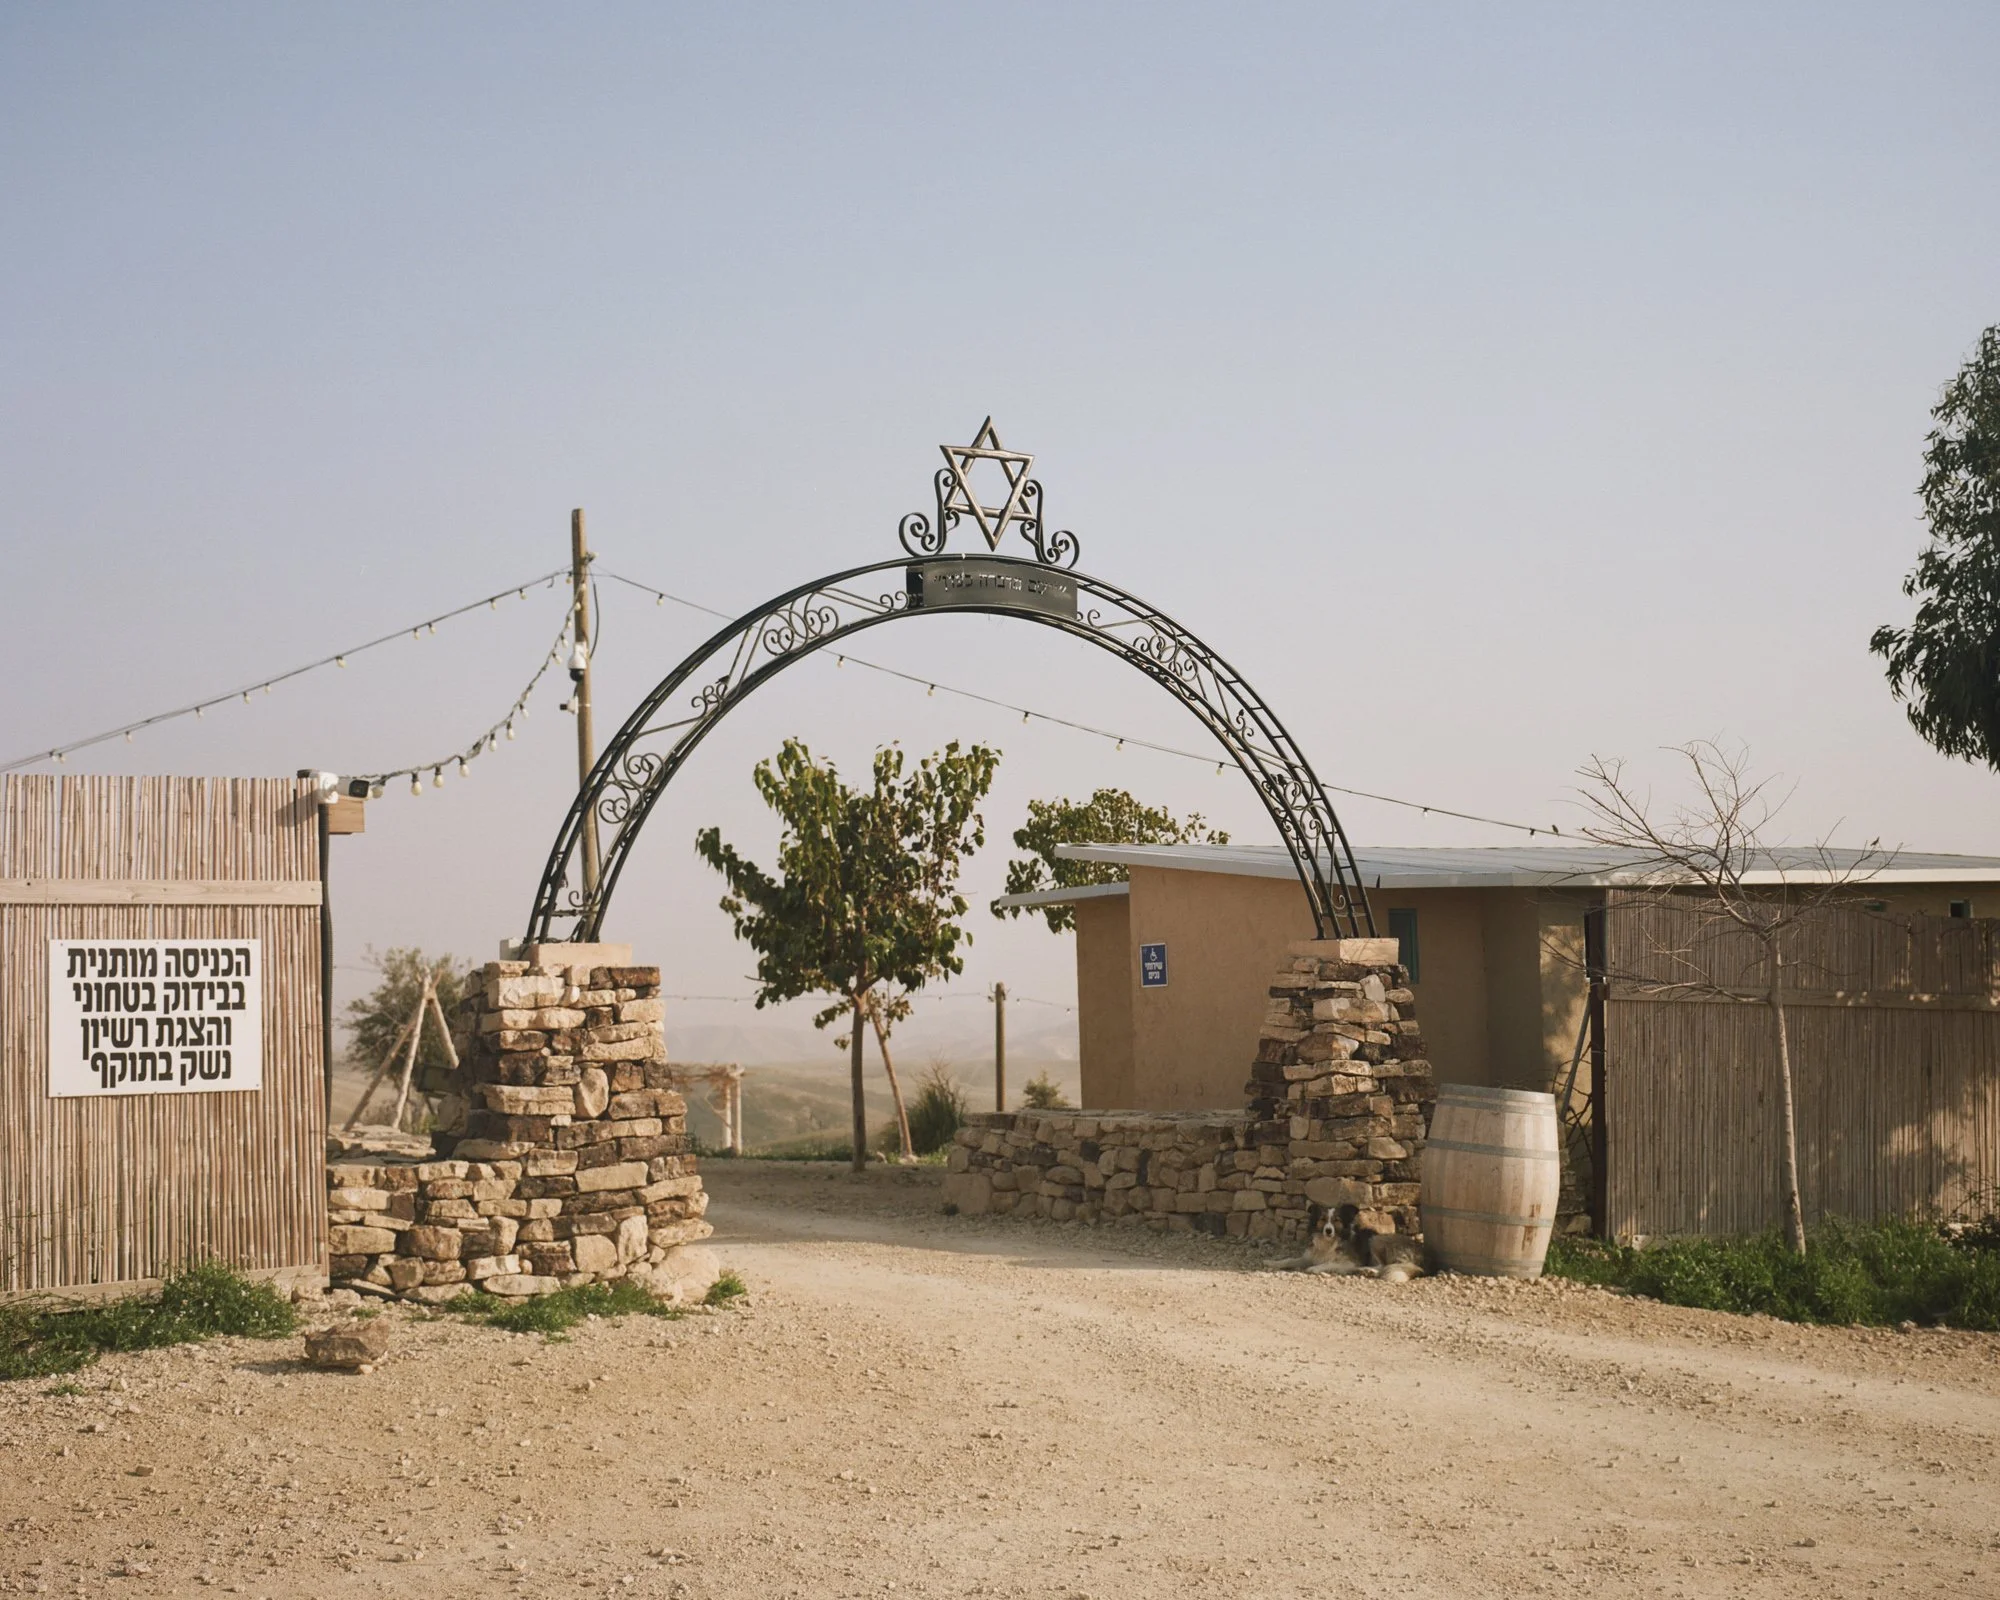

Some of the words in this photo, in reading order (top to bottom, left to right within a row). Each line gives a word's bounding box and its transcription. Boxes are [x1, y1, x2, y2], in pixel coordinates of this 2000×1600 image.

[67, 947, 157, 978] מותנית
[166, 947, 250, 978] הכניסה
[1148, 971, 1160, 980] נכים
[73, 982, 157, 1012] בטחוני
[164, 982, 245, 1014] בבידוק
[81, 1018, 148, 1060] רשיון
[156, 1017, 231, 1047] והצגת
[91, 1052, 173, 1088] בתוקף
[181, 1051, 231, 1086] נשק
